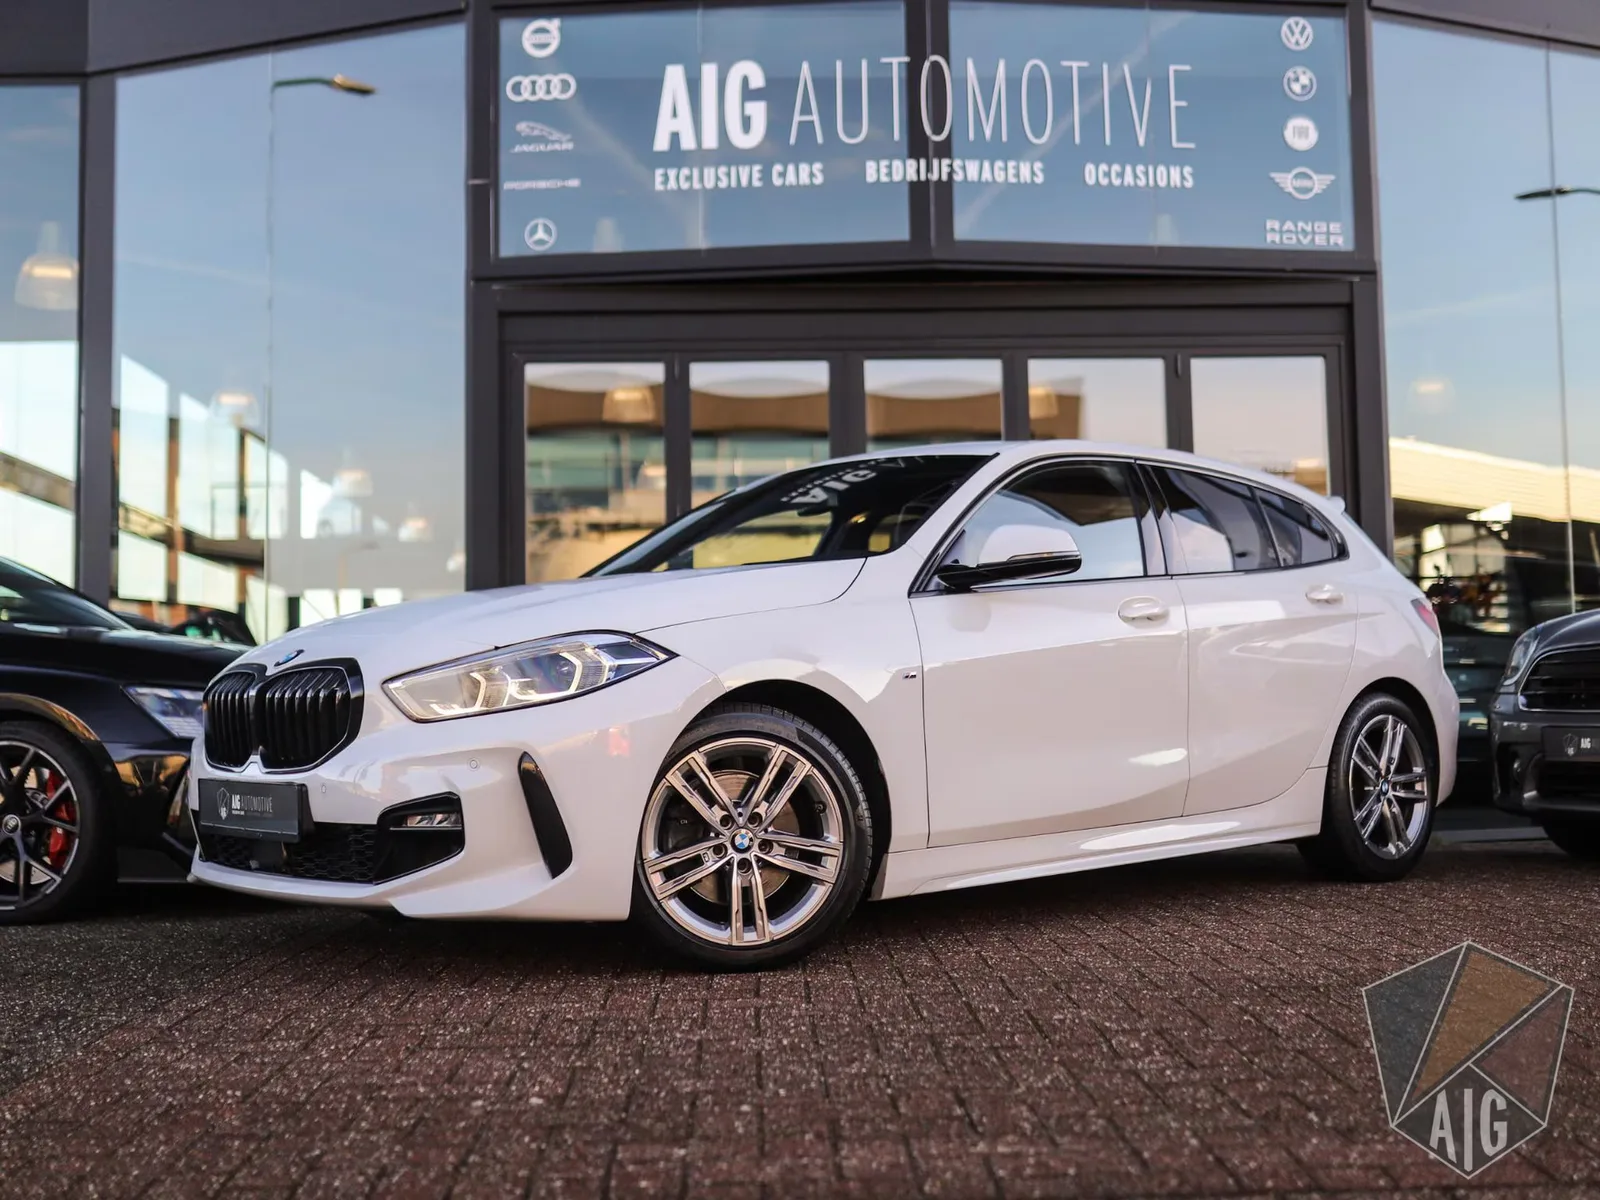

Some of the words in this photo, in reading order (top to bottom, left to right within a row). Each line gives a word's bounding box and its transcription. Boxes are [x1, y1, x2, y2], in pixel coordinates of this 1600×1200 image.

[653, 60, 768, 152] AIG
[789, 55, 1196, 149] AUTOMOTIVE
[654, 164, 764, 191] EXCLUSIVE
[772, 162, 824, 187] CARS
[865, 157, 1045, 184] BEDRIJFSWAGENS
[1084, 162, 1194, 189] OCCASIONS
[1266, 219, 1342, 233] RANGE
[1266, 232, 1344, 246] ROVER
